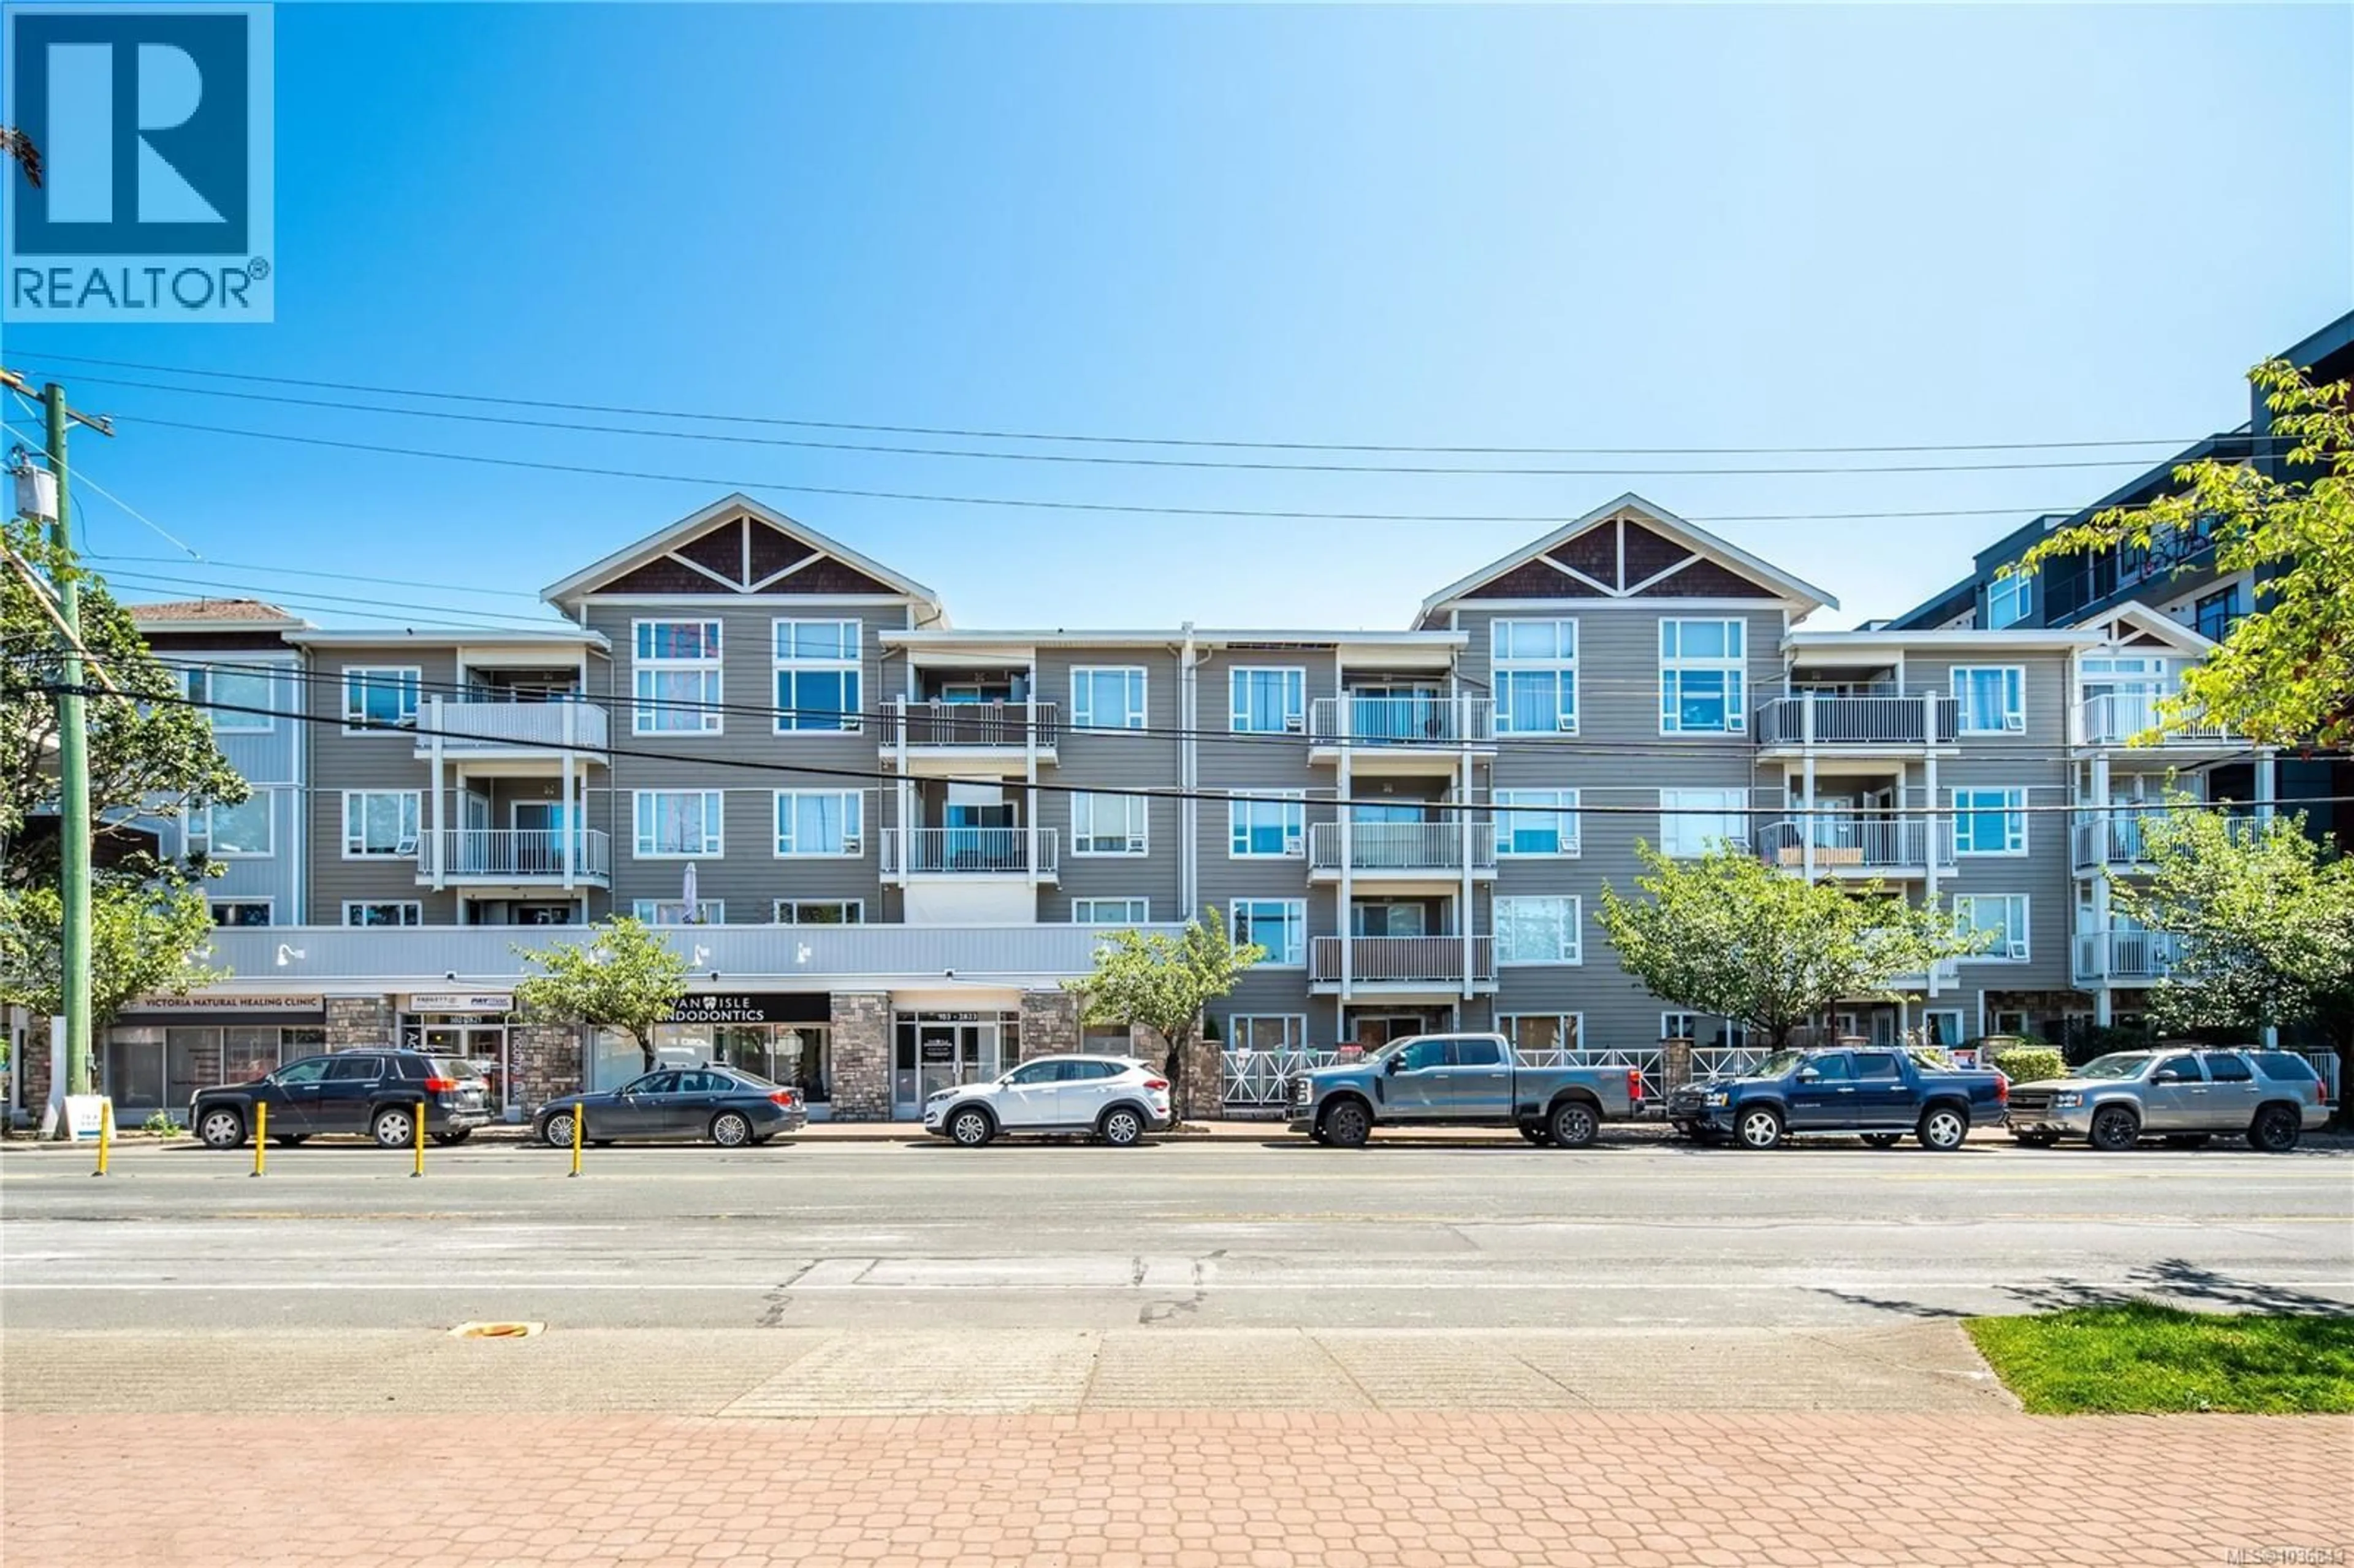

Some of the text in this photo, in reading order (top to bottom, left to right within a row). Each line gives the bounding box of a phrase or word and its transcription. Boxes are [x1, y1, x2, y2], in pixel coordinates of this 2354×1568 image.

[145, 998, 317, 1007] VICTORIA NATURAL HEALING CLINIC
[669, 997, 750, 1008] VAN ISLE
[657, 1010, 764, 1022] NDODONTICS
